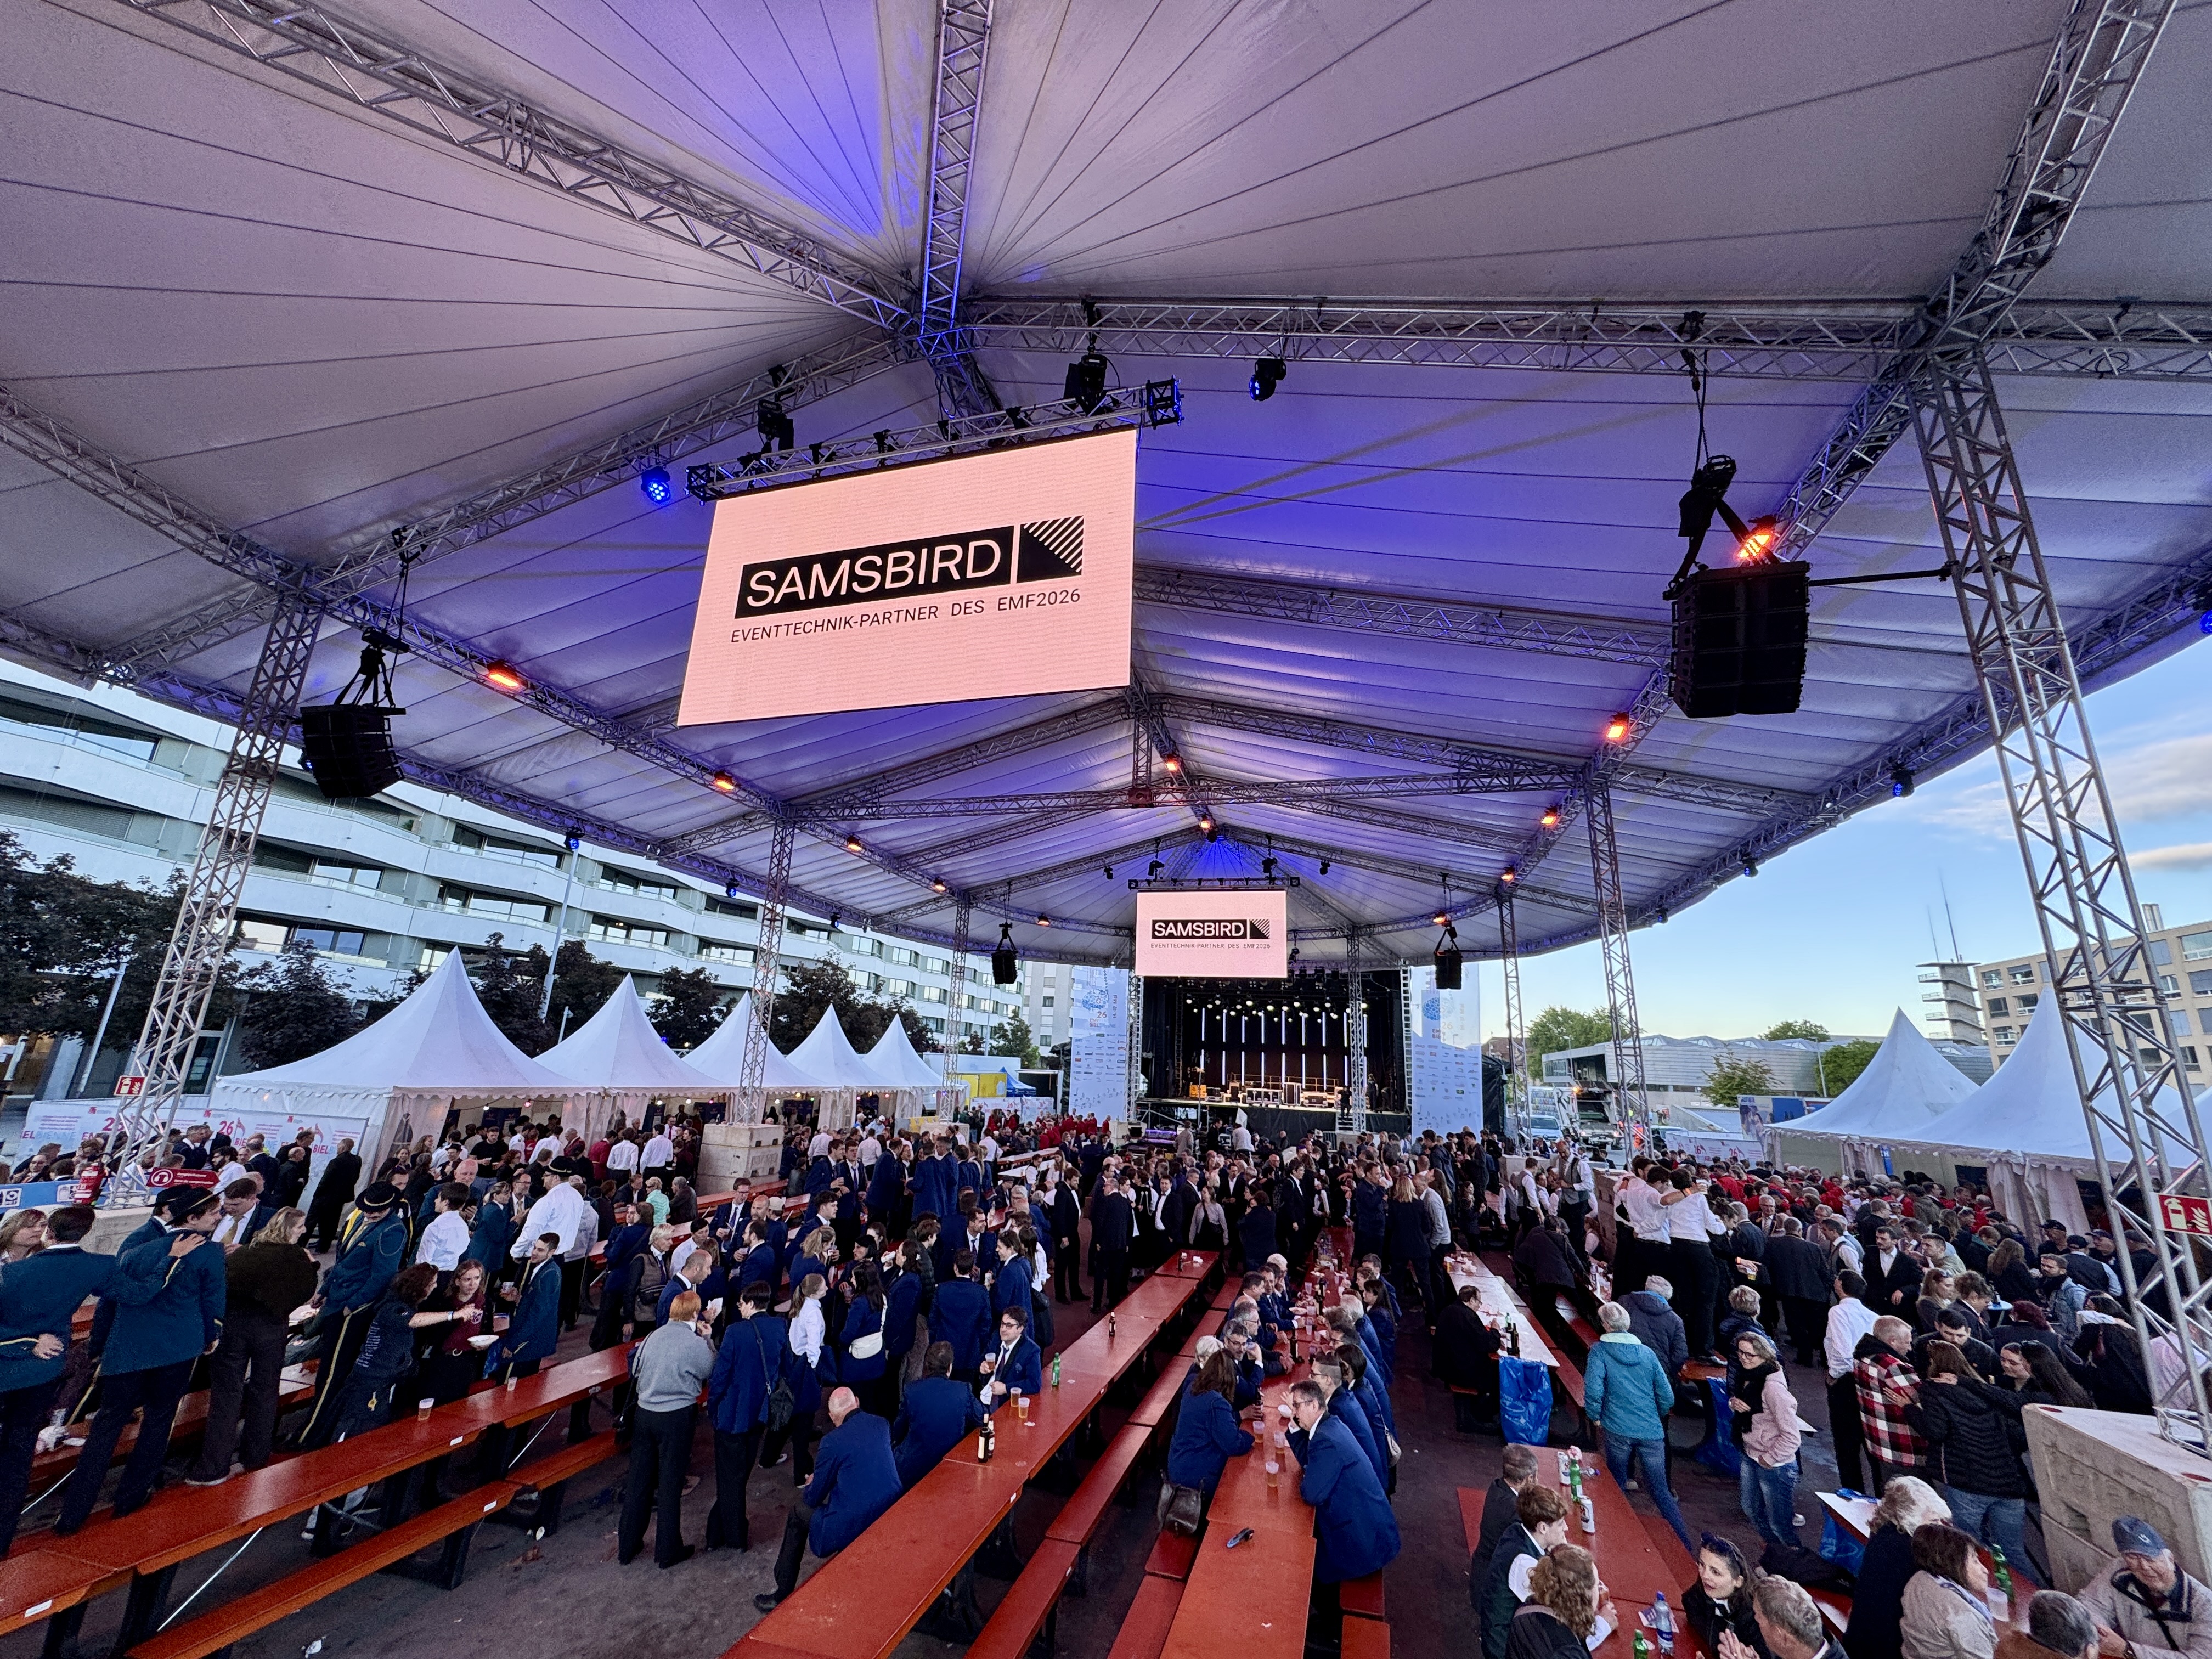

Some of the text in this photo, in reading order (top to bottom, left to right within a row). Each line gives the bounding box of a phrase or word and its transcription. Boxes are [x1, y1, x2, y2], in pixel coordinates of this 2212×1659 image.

[747, 539, 1001, 607] SAMSBIRD
[731, 588, 1080, 643] EVENTTECHNIK-PARTNER DES EMF2026
[1154, 922, 1245, 937] SAMSBIRD
[1097, 1011, 1108, 1019] 26
[218, 1120, 235, 1136] 26
[234, 1137, 247, 1147] BIE
[313, 1144, 329, 1154] BIEL
